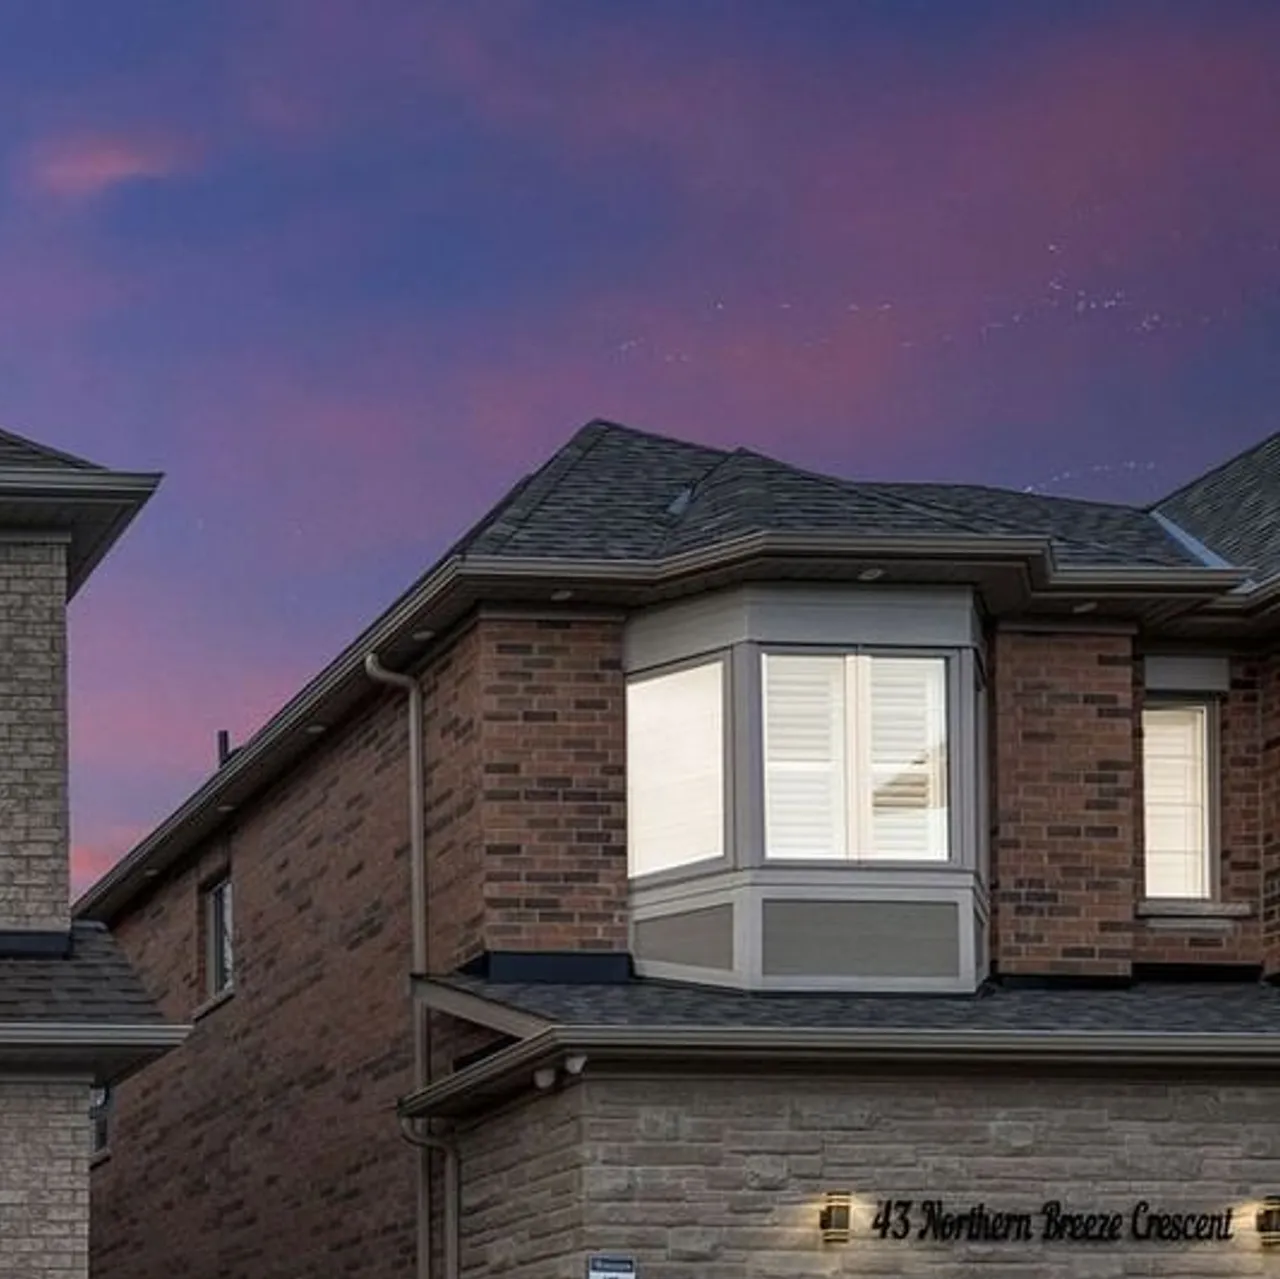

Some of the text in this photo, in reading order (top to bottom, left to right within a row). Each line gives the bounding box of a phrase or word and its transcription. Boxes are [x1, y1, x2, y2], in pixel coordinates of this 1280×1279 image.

[871, 1199, 1236, 1242] 43 Northern Breeze Crescent
